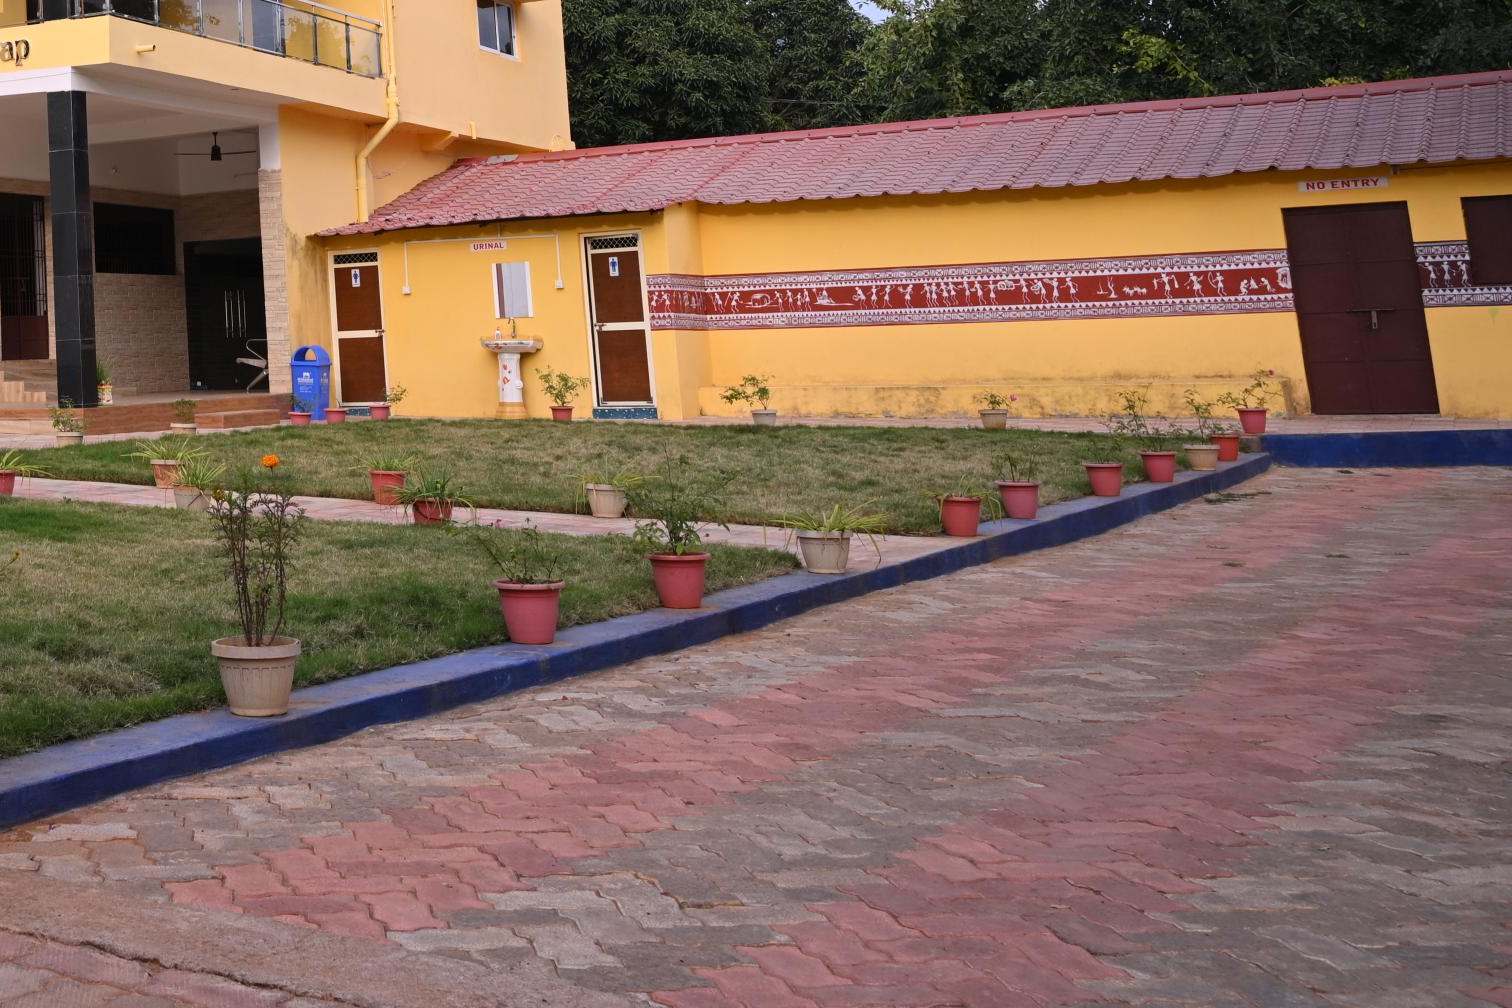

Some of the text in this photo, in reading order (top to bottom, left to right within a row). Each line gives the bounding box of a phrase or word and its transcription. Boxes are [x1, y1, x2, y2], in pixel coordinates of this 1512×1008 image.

[1305, 178, 1380, 190] NO ENTRY
[473, 242, 504, 250] URINAL
